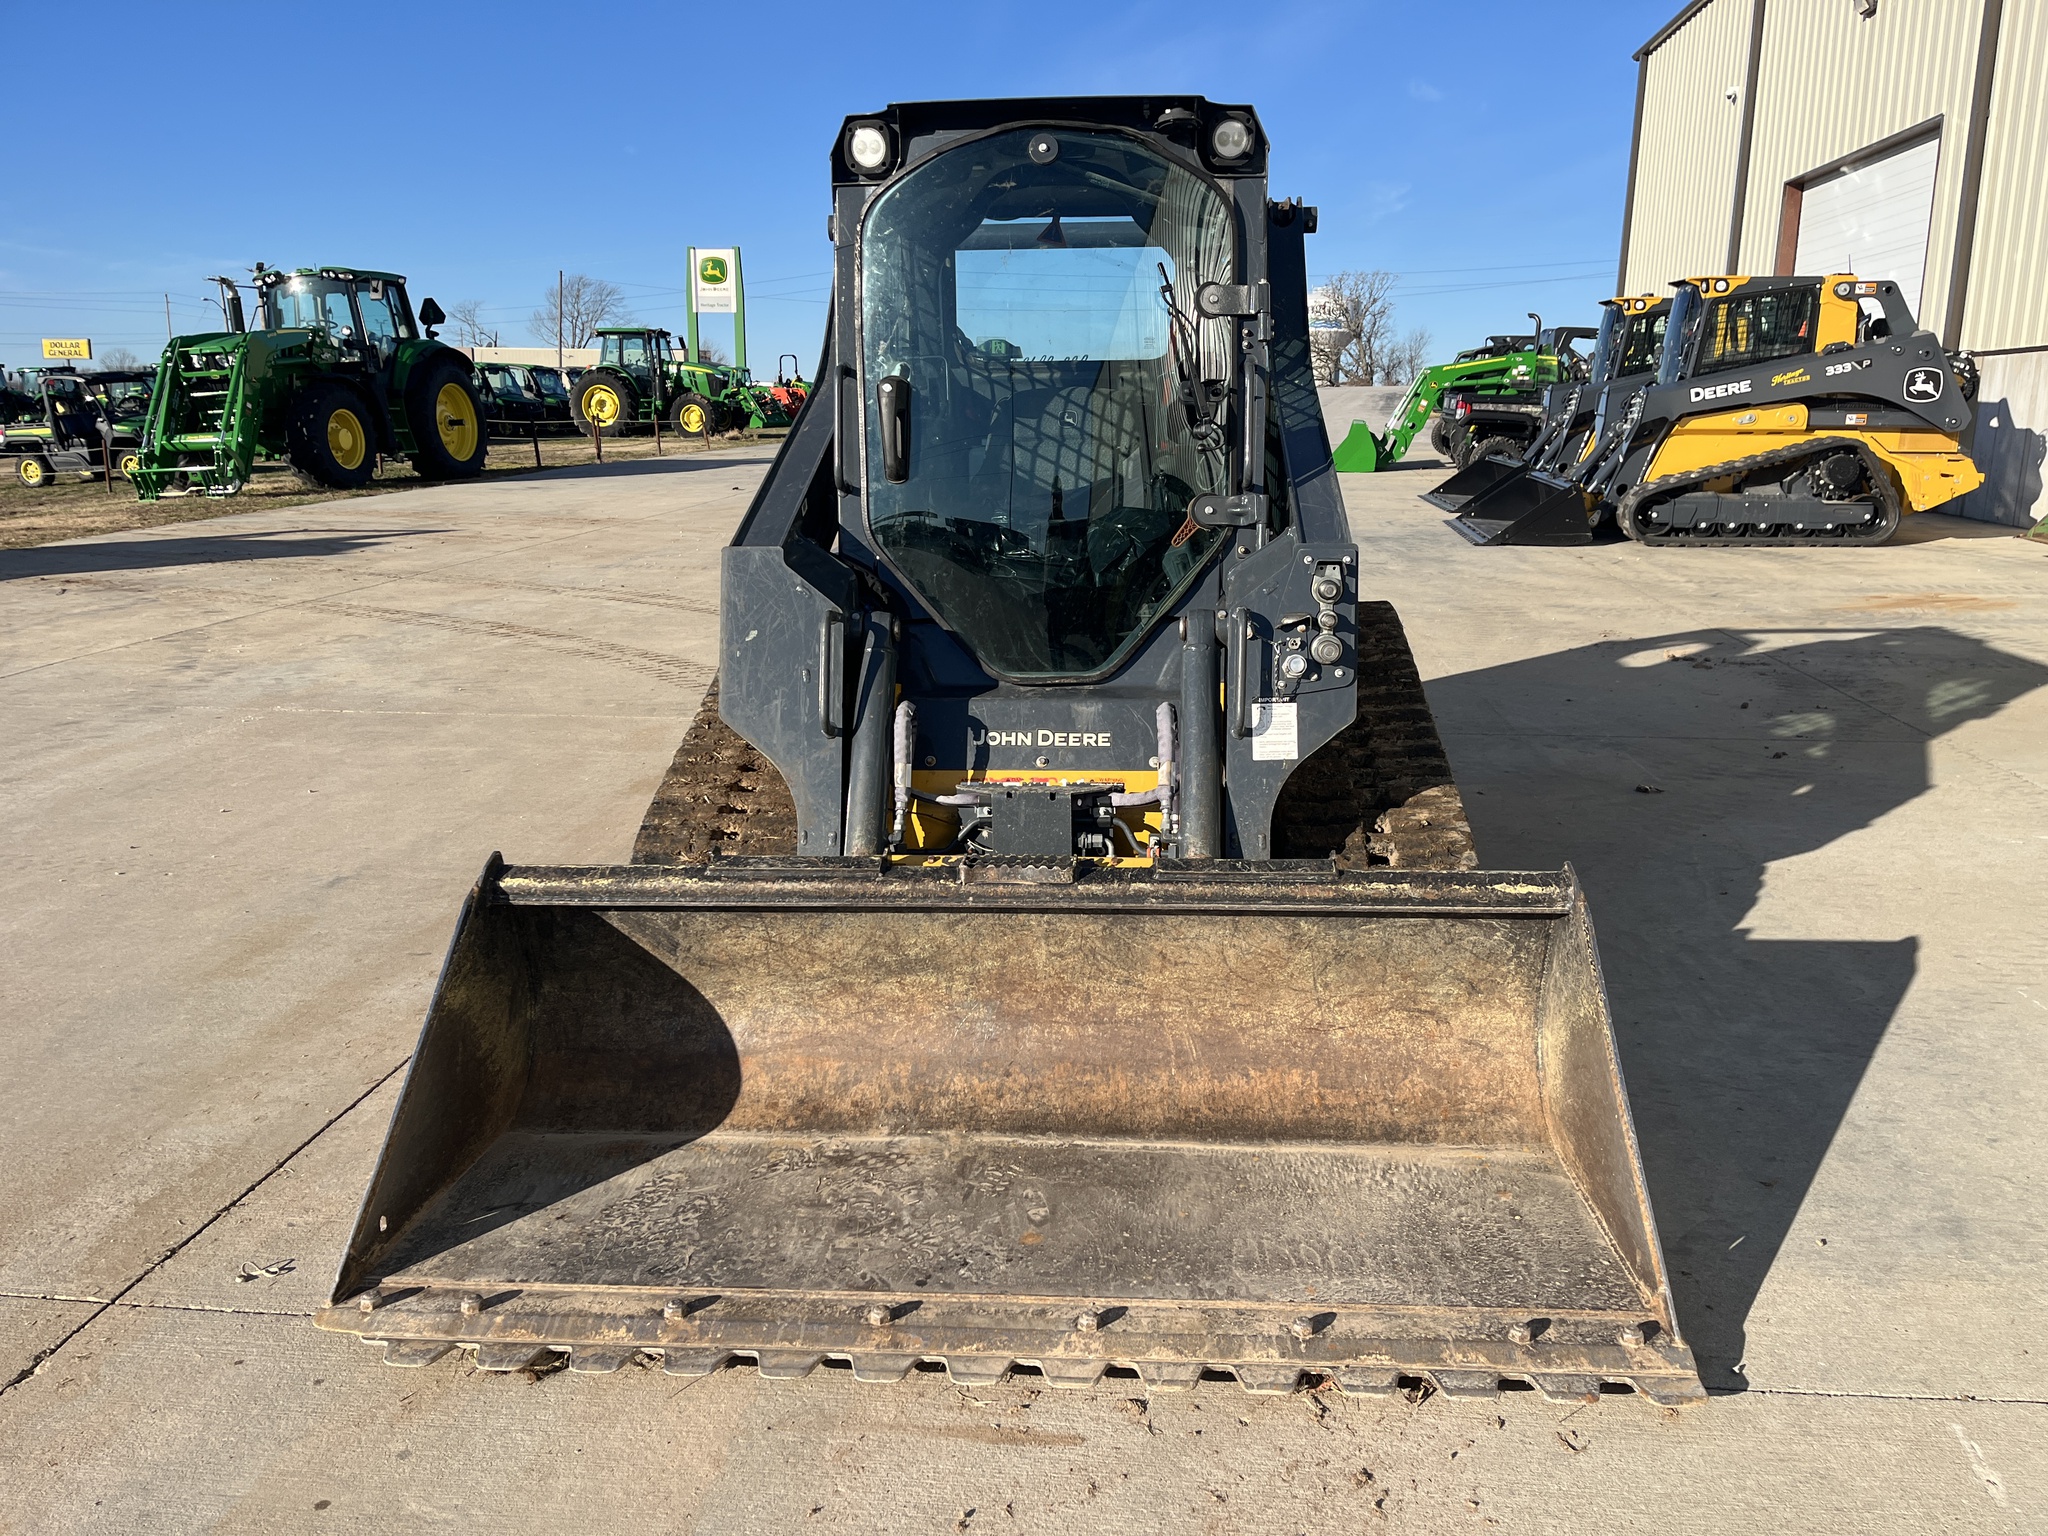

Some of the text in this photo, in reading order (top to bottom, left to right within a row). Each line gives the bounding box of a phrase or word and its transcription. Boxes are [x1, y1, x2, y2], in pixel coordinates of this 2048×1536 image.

[49, 341, 81, 349] DOLLAR
[48, 349, 83, 357] GENERAL
[1825, 362, 1852, 377] 333
[1690, 379, 1752, 403] DEERE
[973, 729, 1111, 747] JOHN DEERE
